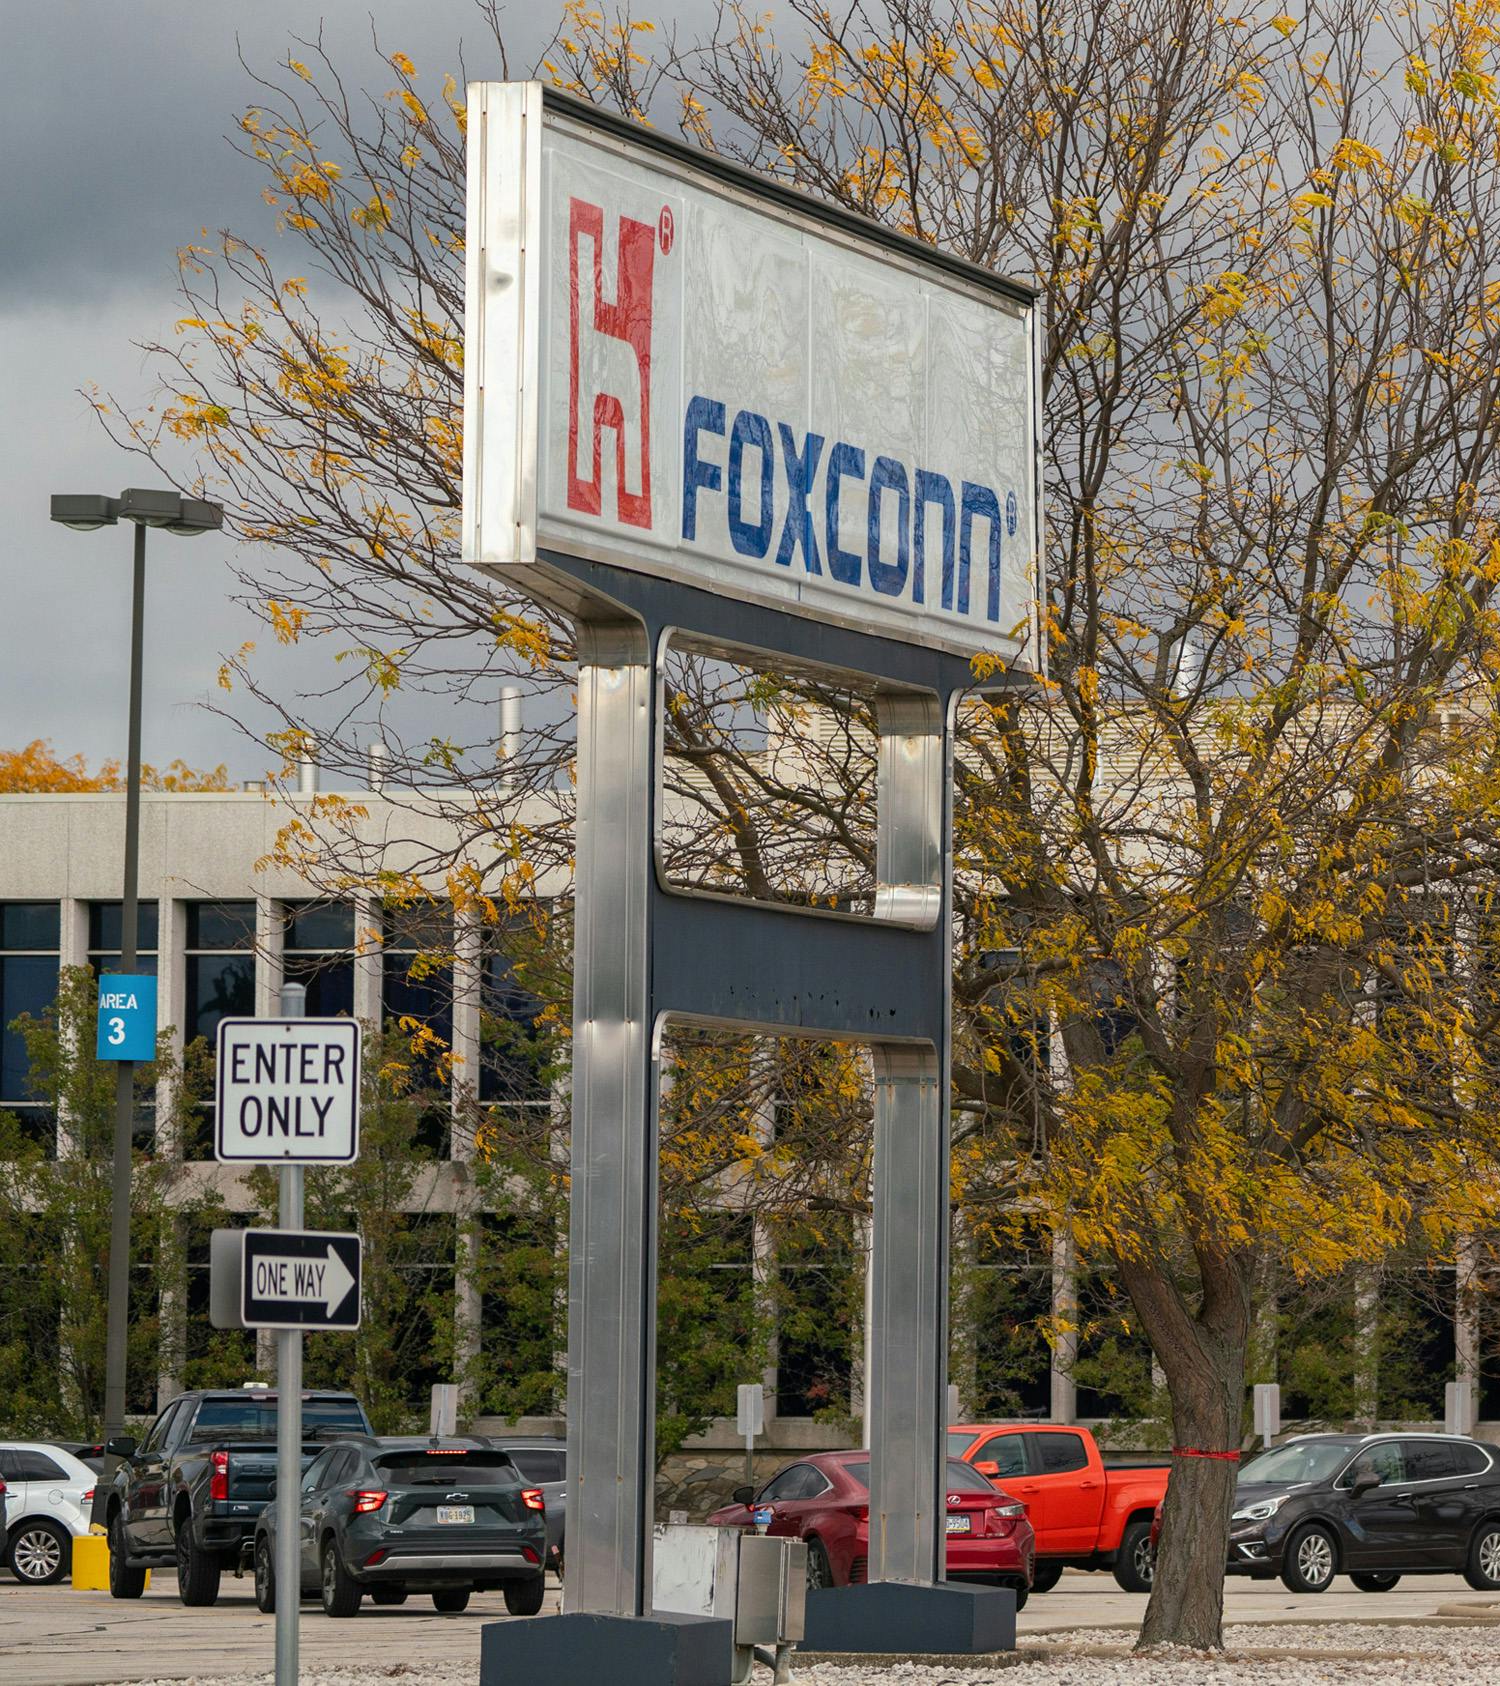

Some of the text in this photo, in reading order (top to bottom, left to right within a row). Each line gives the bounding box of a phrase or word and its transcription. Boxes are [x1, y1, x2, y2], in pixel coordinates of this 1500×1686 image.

[99, 993, 138, 1010] AREA
[107, 1016, 126, 1046] 3
[231, 1043, 345, 1085] ENTER
[239, 1095, 335, 1137] ONLY
[256, 1262, 326, 1297] ONE WAY
